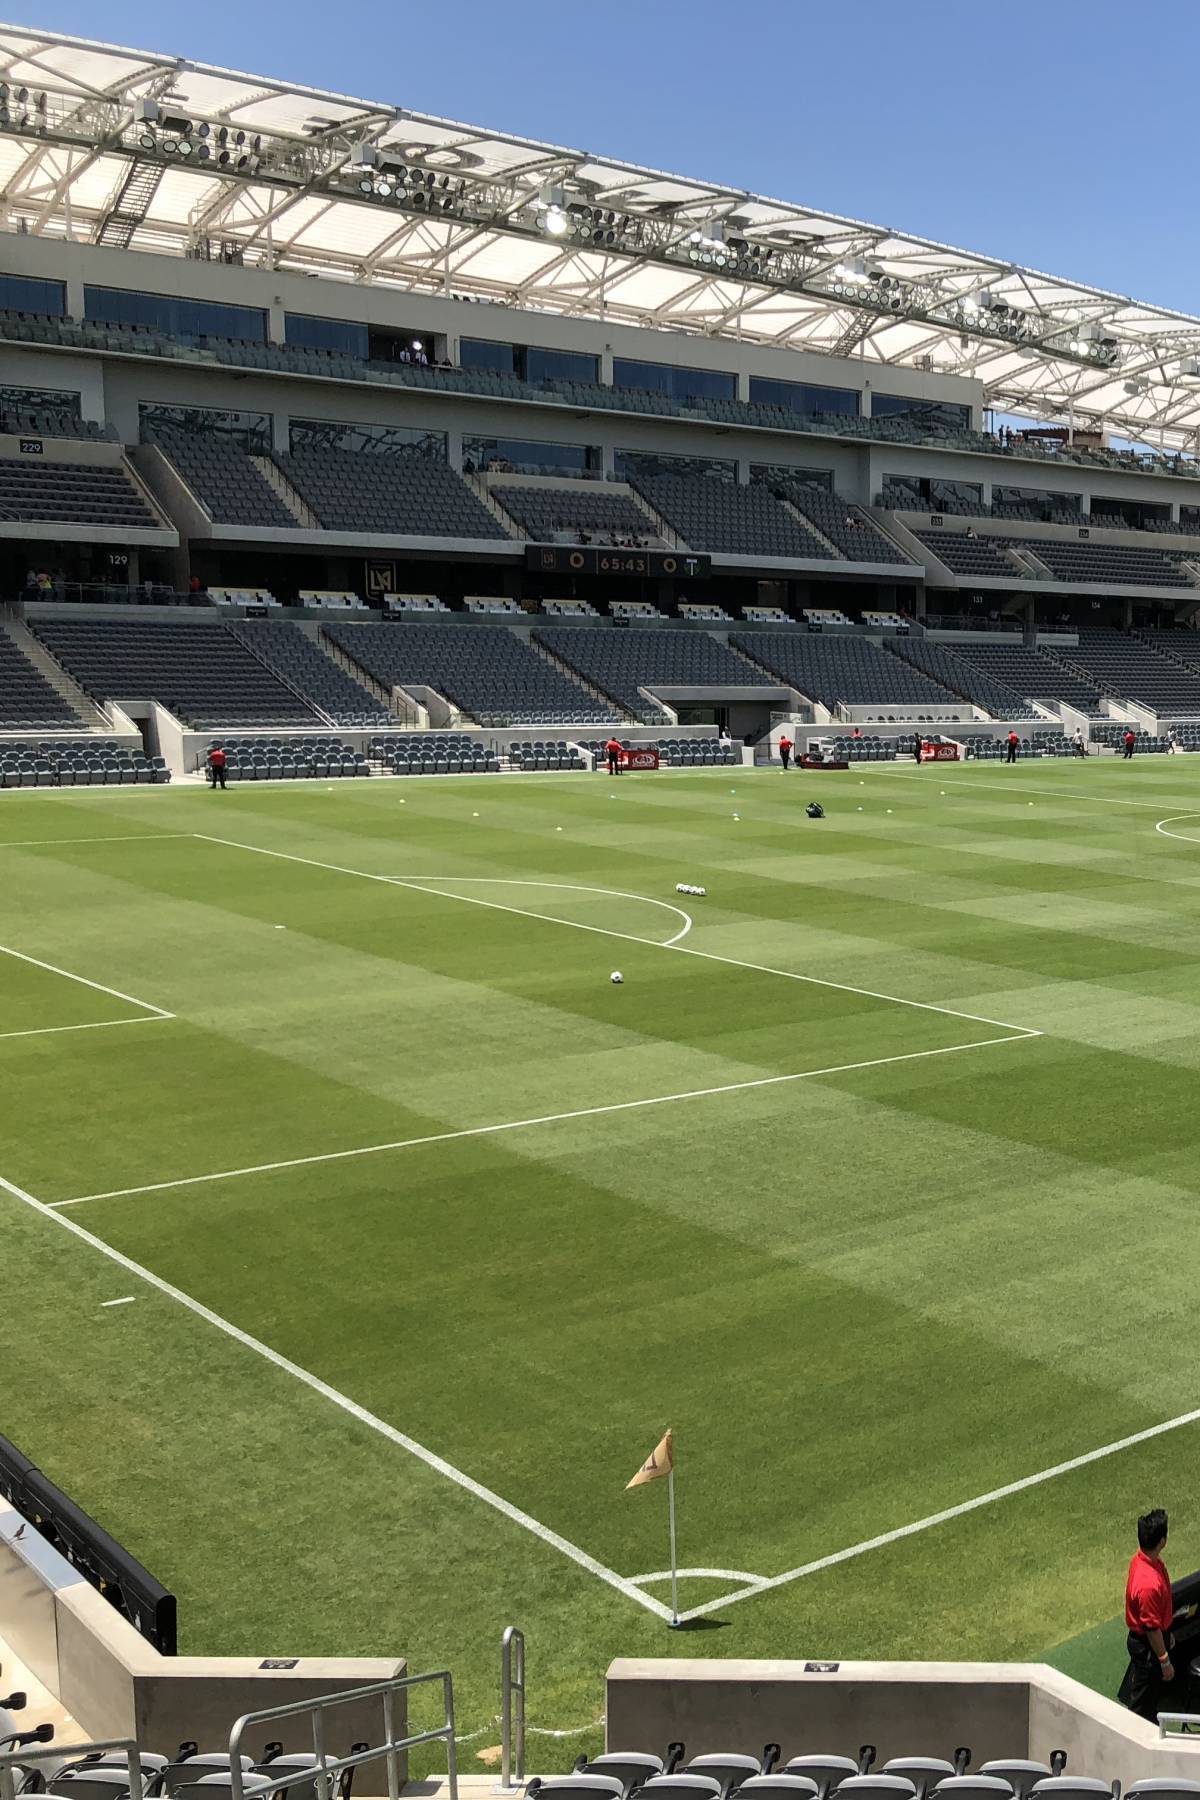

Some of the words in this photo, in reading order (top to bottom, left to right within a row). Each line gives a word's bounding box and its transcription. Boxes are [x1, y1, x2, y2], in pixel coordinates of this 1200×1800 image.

[22, 442, 41, 452] 229
[109, 555, 128, 565] 129
[600, 558, 645, 571] 65:43
